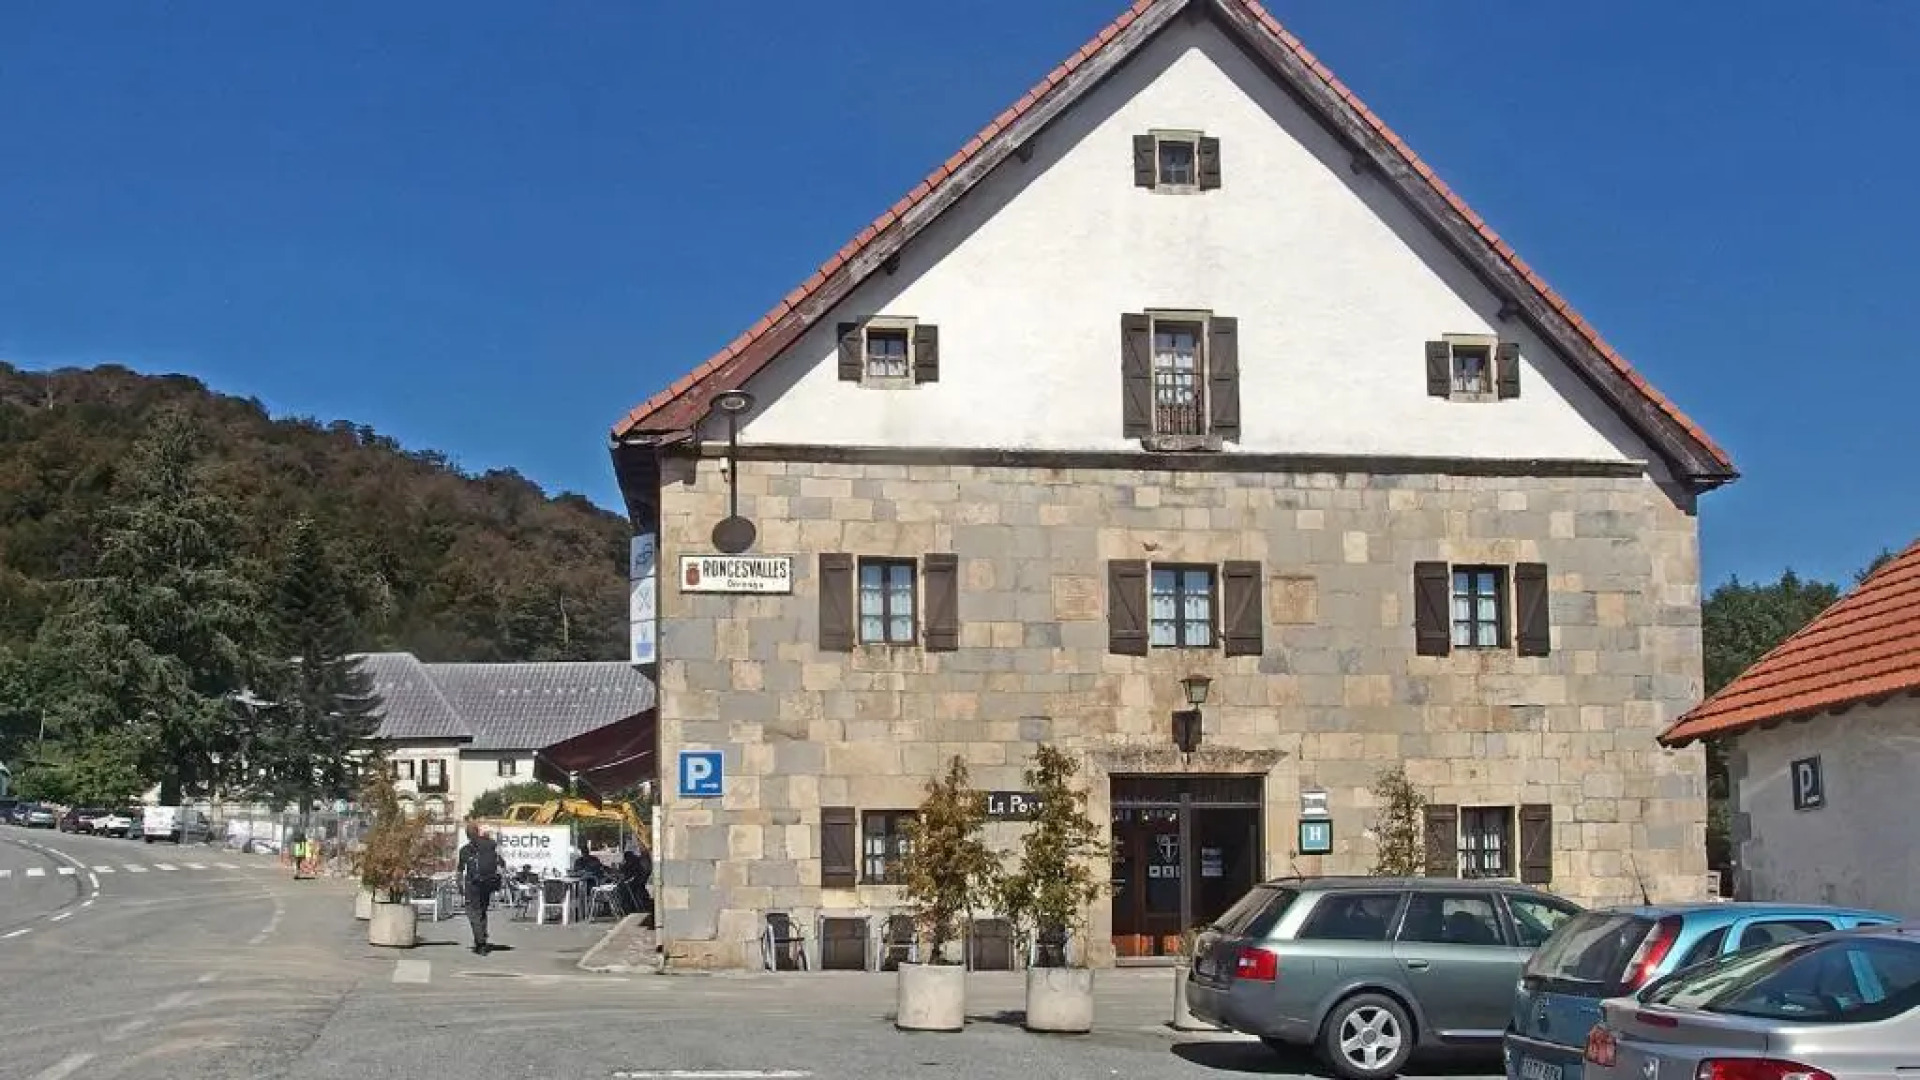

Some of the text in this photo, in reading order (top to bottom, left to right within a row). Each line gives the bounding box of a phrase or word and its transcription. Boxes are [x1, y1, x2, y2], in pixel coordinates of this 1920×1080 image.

[703, 560, 787, 578] RONCESVALLES
[687, 756, 712, 790] P
[1798, 763, 1812, 806] P
[1310, 826, 1321, 841] H
